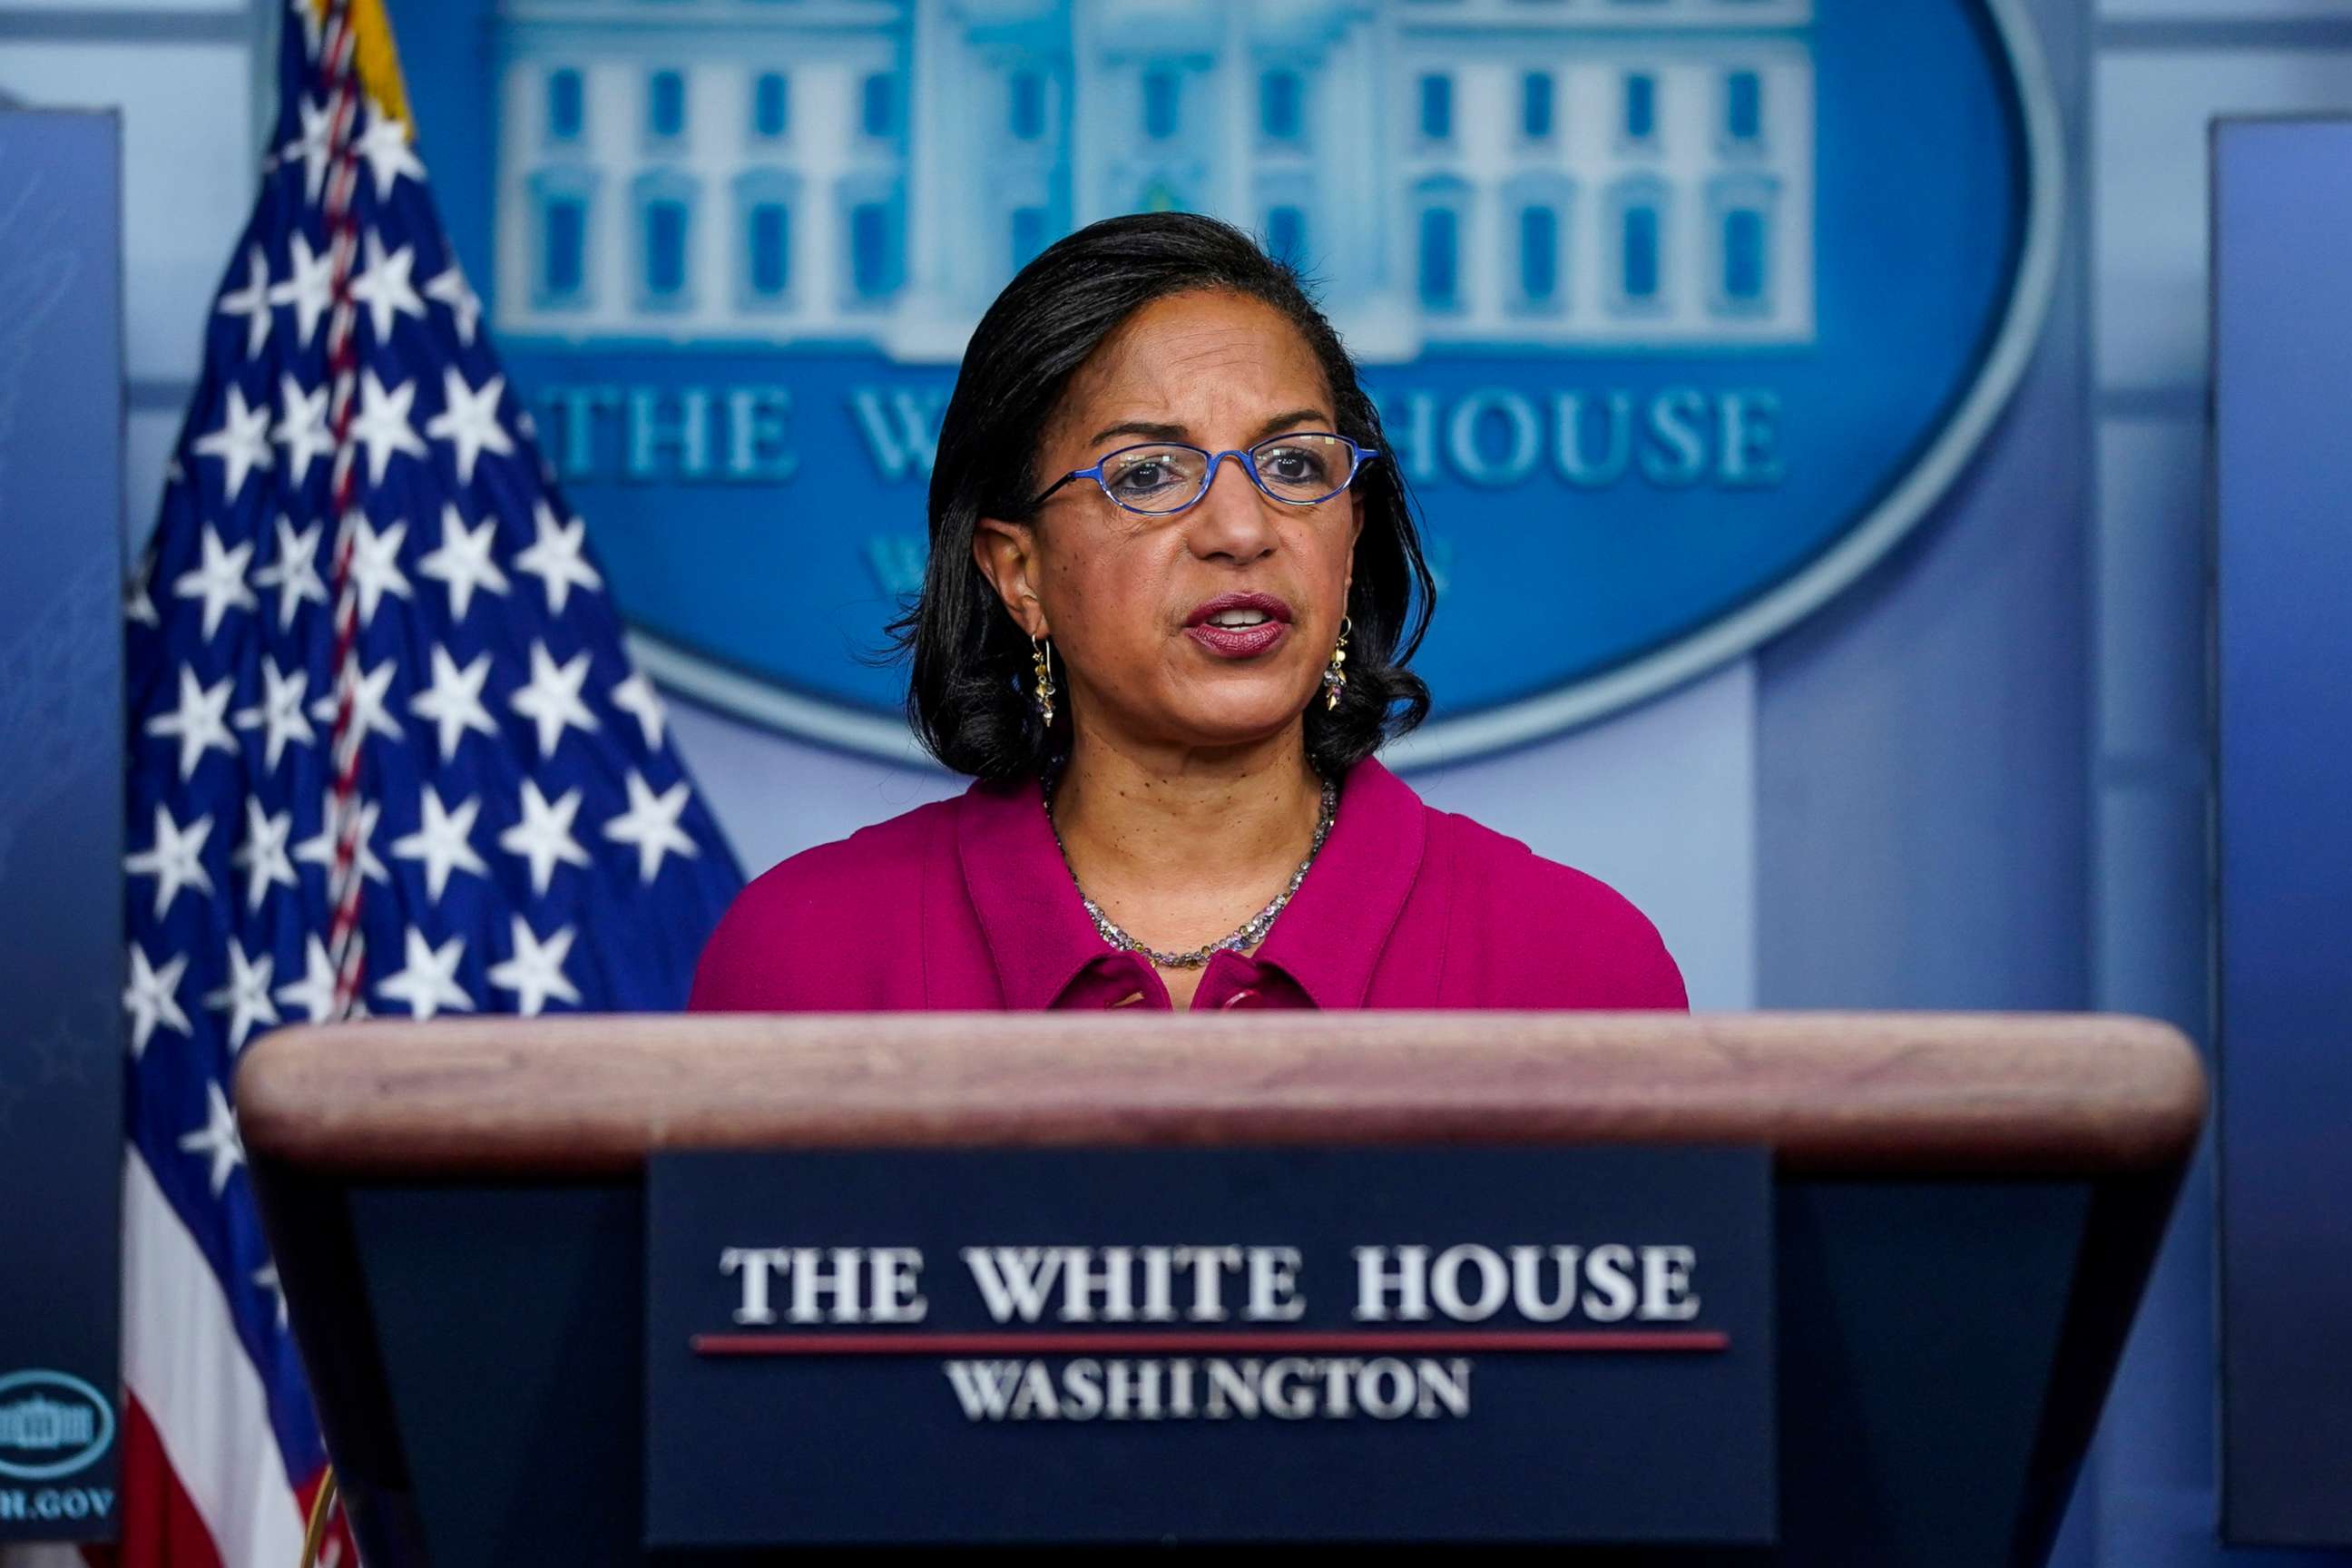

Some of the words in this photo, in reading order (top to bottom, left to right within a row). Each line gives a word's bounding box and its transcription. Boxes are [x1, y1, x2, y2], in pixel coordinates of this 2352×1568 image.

[538, 386, 799, 481] THE
[720, 1246, 928, 1324] THE
[965, 1244, 1306, 1324] WHITE
[1352, 1244, 1700, 1322] HOUSE
[946, 1358, 1475, 1422] WASHINGTON
